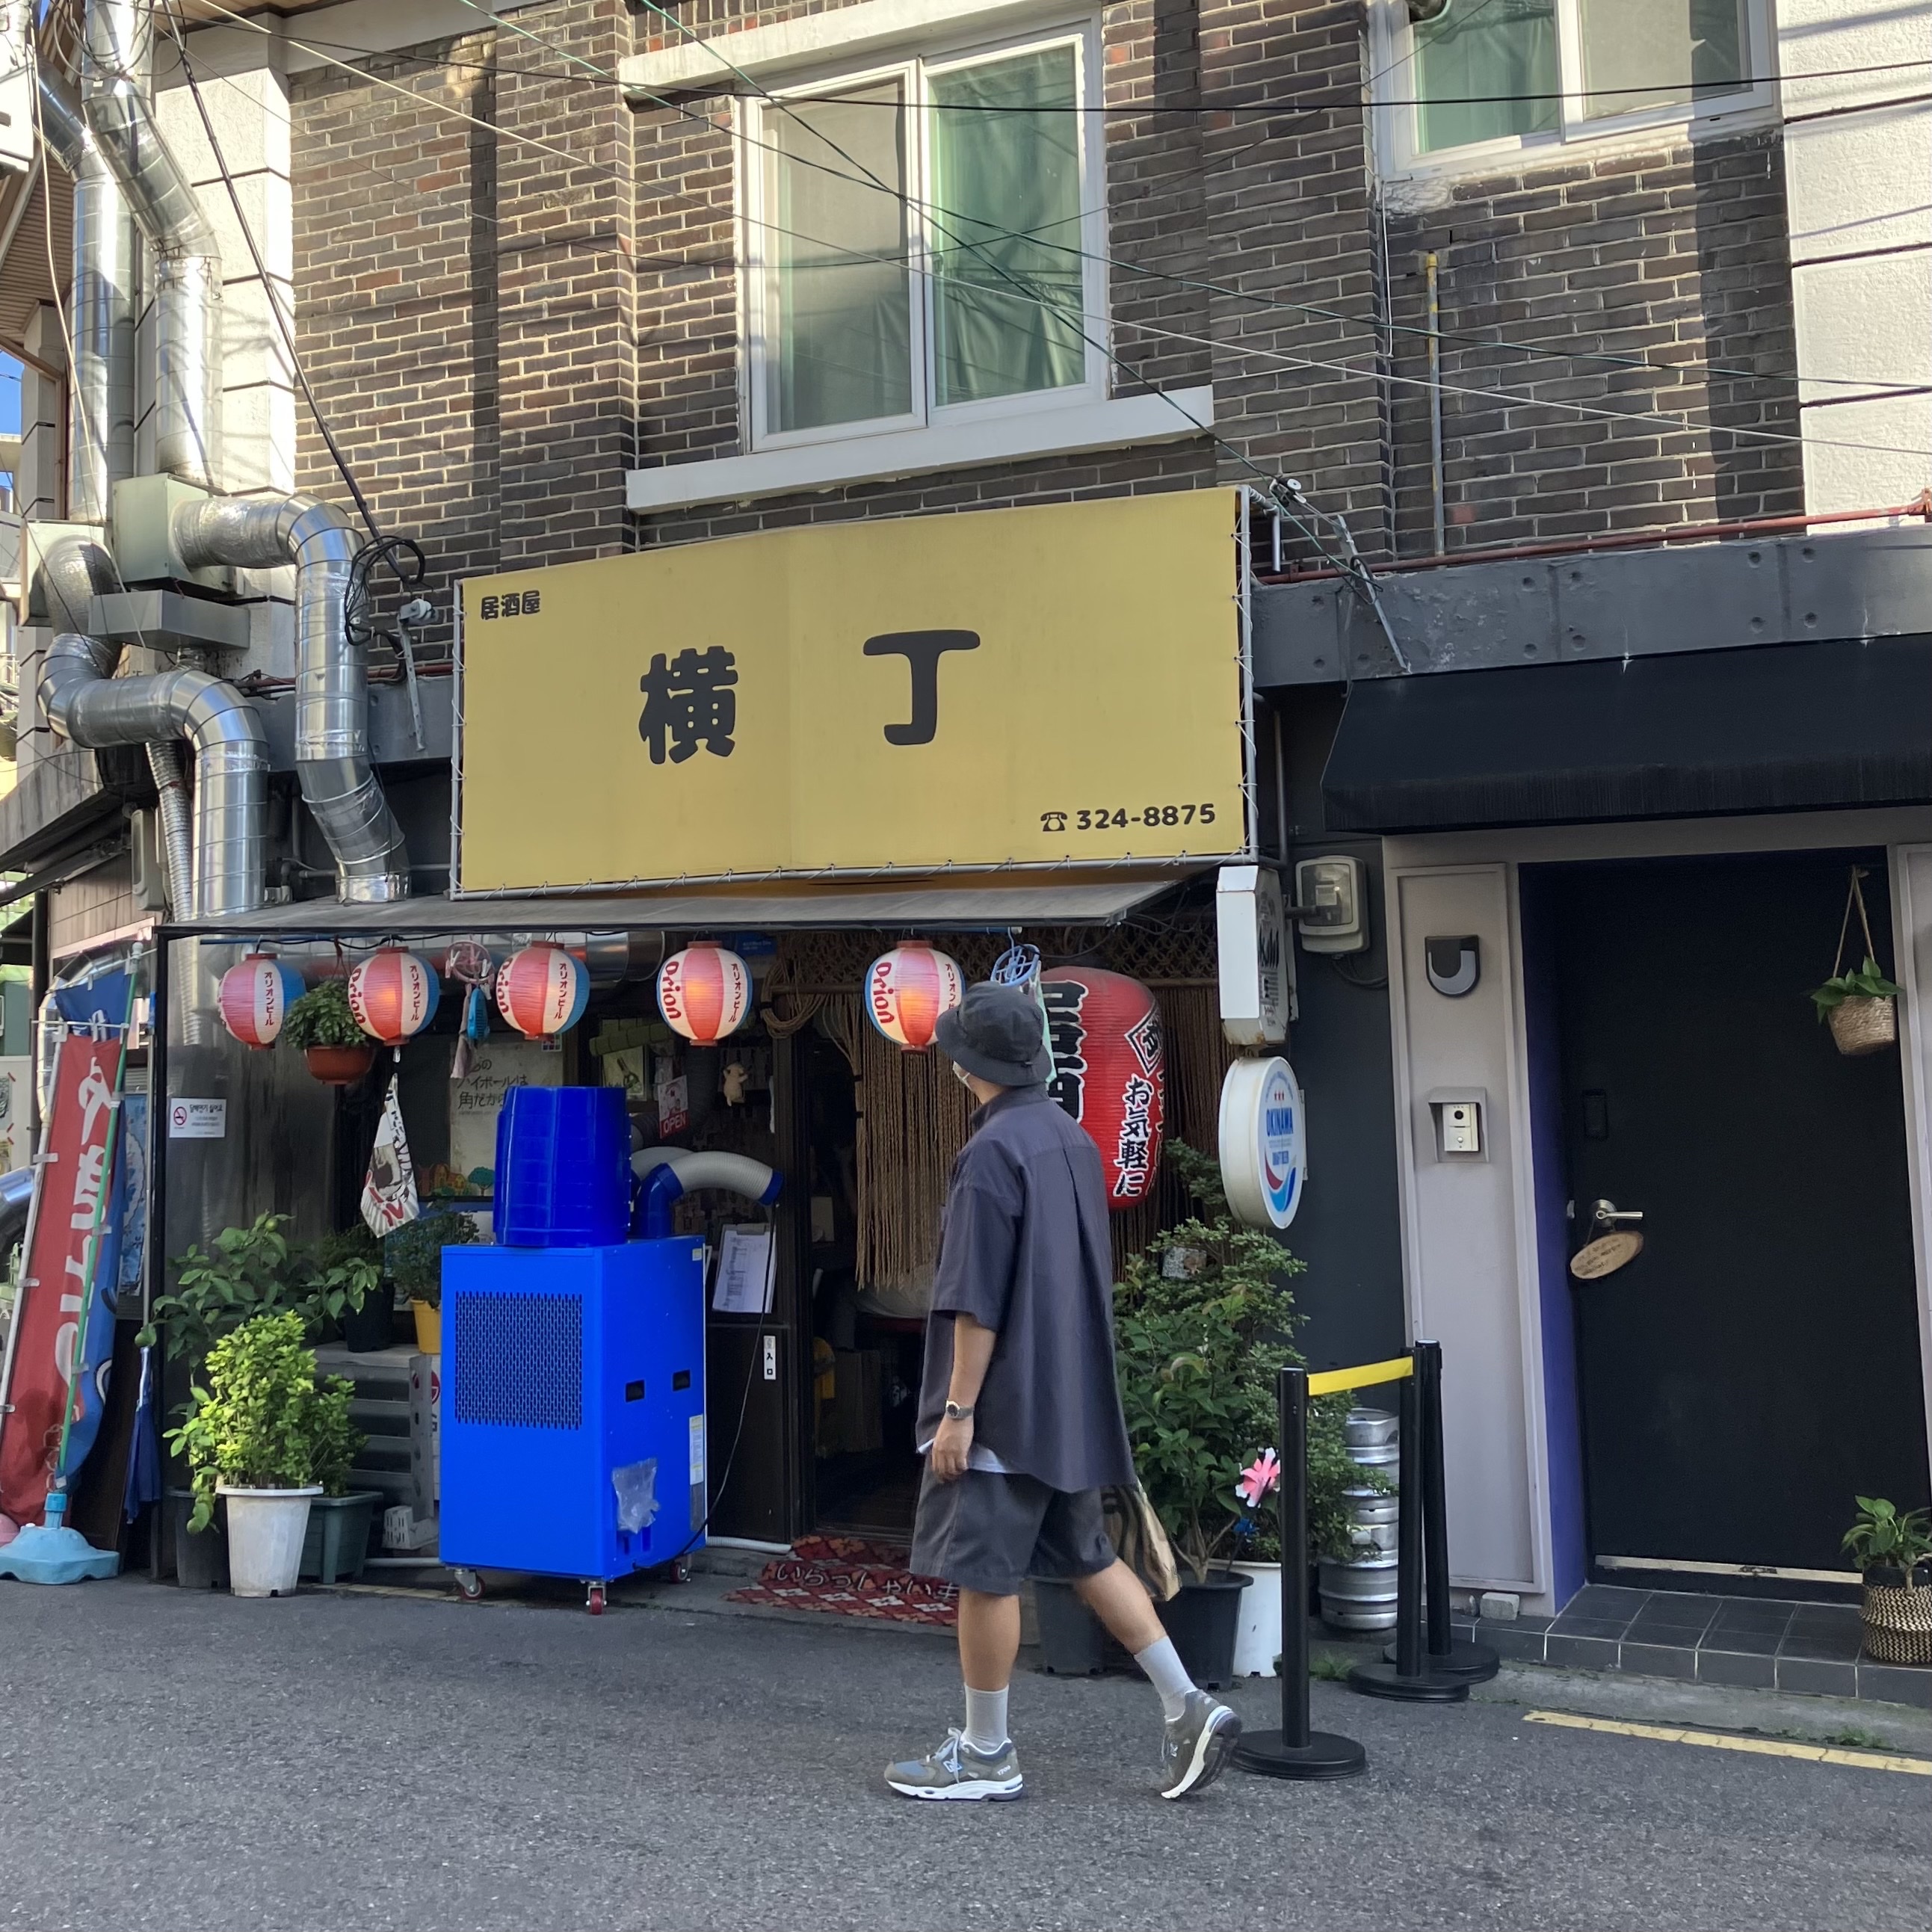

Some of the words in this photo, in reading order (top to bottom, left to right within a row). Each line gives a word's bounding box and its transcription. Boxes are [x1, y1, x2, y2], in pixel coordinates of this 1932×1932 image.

[481, 590, 540, 620] 居酒屋
[1076, 803, 1216, 830] 324-8875
[264, 972, 275, 1026] オリオンビール
[409, 965, 421, 1022] オリオンビール
[555, 962, 568, 1019] オリオンビール
[662, 960, 682, 1019] Orion
[729, 963, 742, 1022] オリオンビール
[873, 962, 895, 1024] Orion
[663, 1112, 687, 1134] OPEN
[1116, 1075, 1153, 1197] お気軽に
[766, 1352, 774, 1375] 入口
